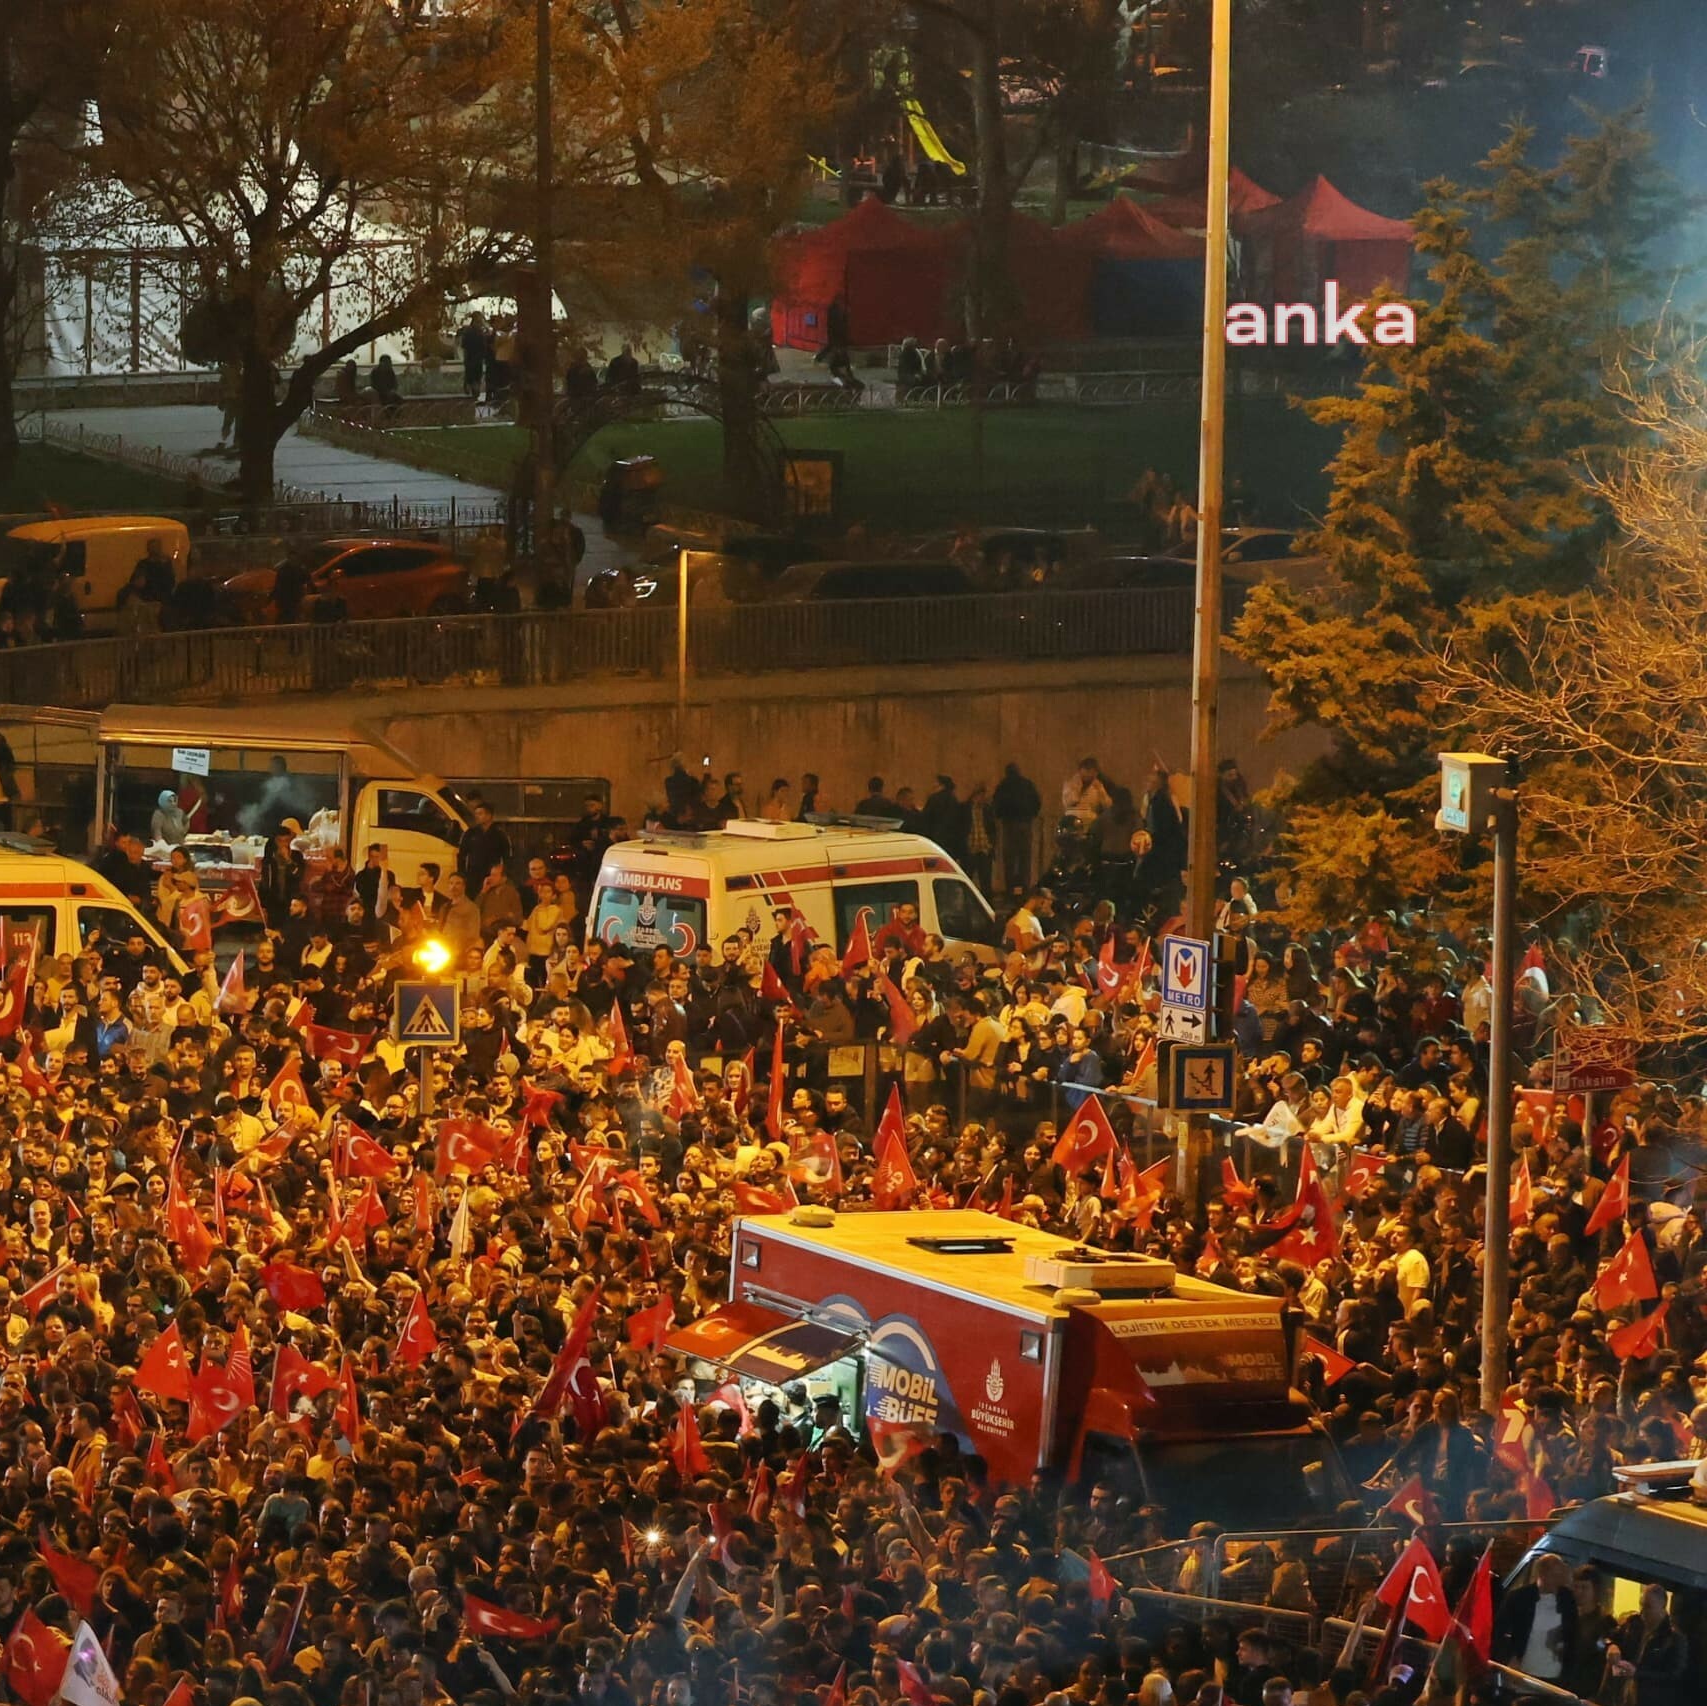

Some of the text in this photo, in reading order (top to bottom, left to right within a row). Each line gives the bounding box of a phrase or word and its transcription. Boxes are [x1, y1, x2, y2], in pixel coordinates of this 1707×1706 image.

[615, 872, 684, 891] AMBULANS
[1167, 990, 1201, 1006] METRO
[1570, 1075, 1616, 1088] Taksim
[1111, 1315, 1279, 1335] LOJİSTİK DESTEK MERKEZİ
[874, 1363, 938, 1406] MOBİL
[971, 1408, 1016, 1431] BÜYÜKŞEHİR
